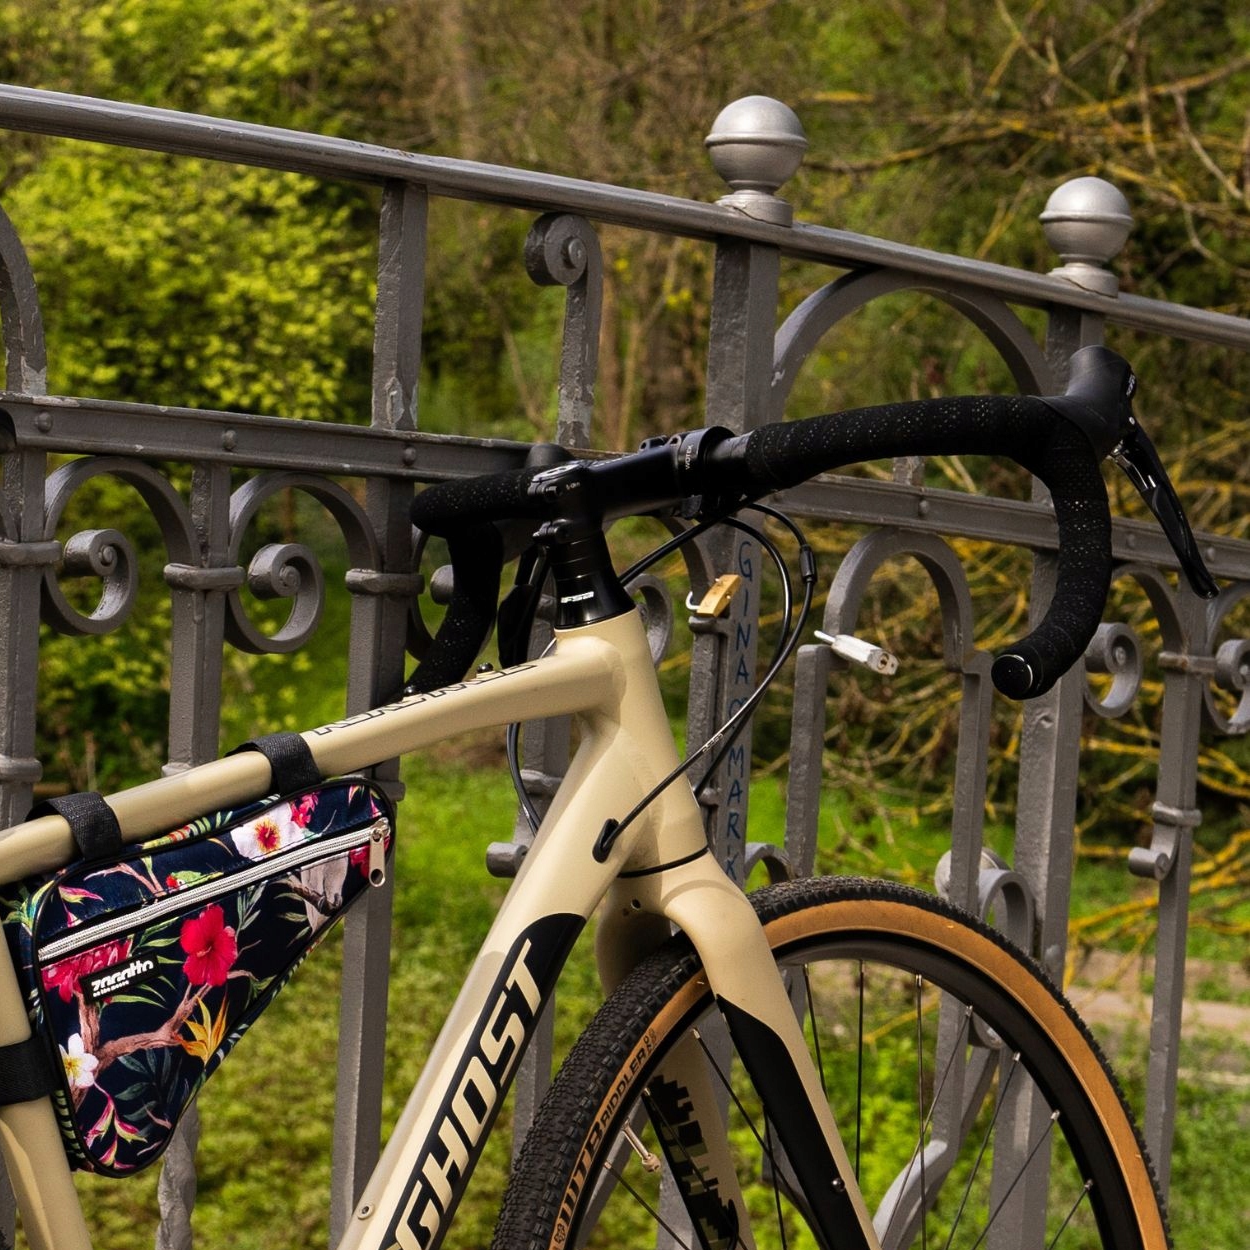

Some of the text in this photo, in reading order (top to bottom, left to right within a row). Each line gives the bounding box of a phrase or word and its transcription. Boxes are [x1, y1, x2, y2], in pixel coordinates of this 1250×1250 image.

[735, 541, 753, 685] GINA
[558, 1047, 648, 1228] WTB RIDDLER
